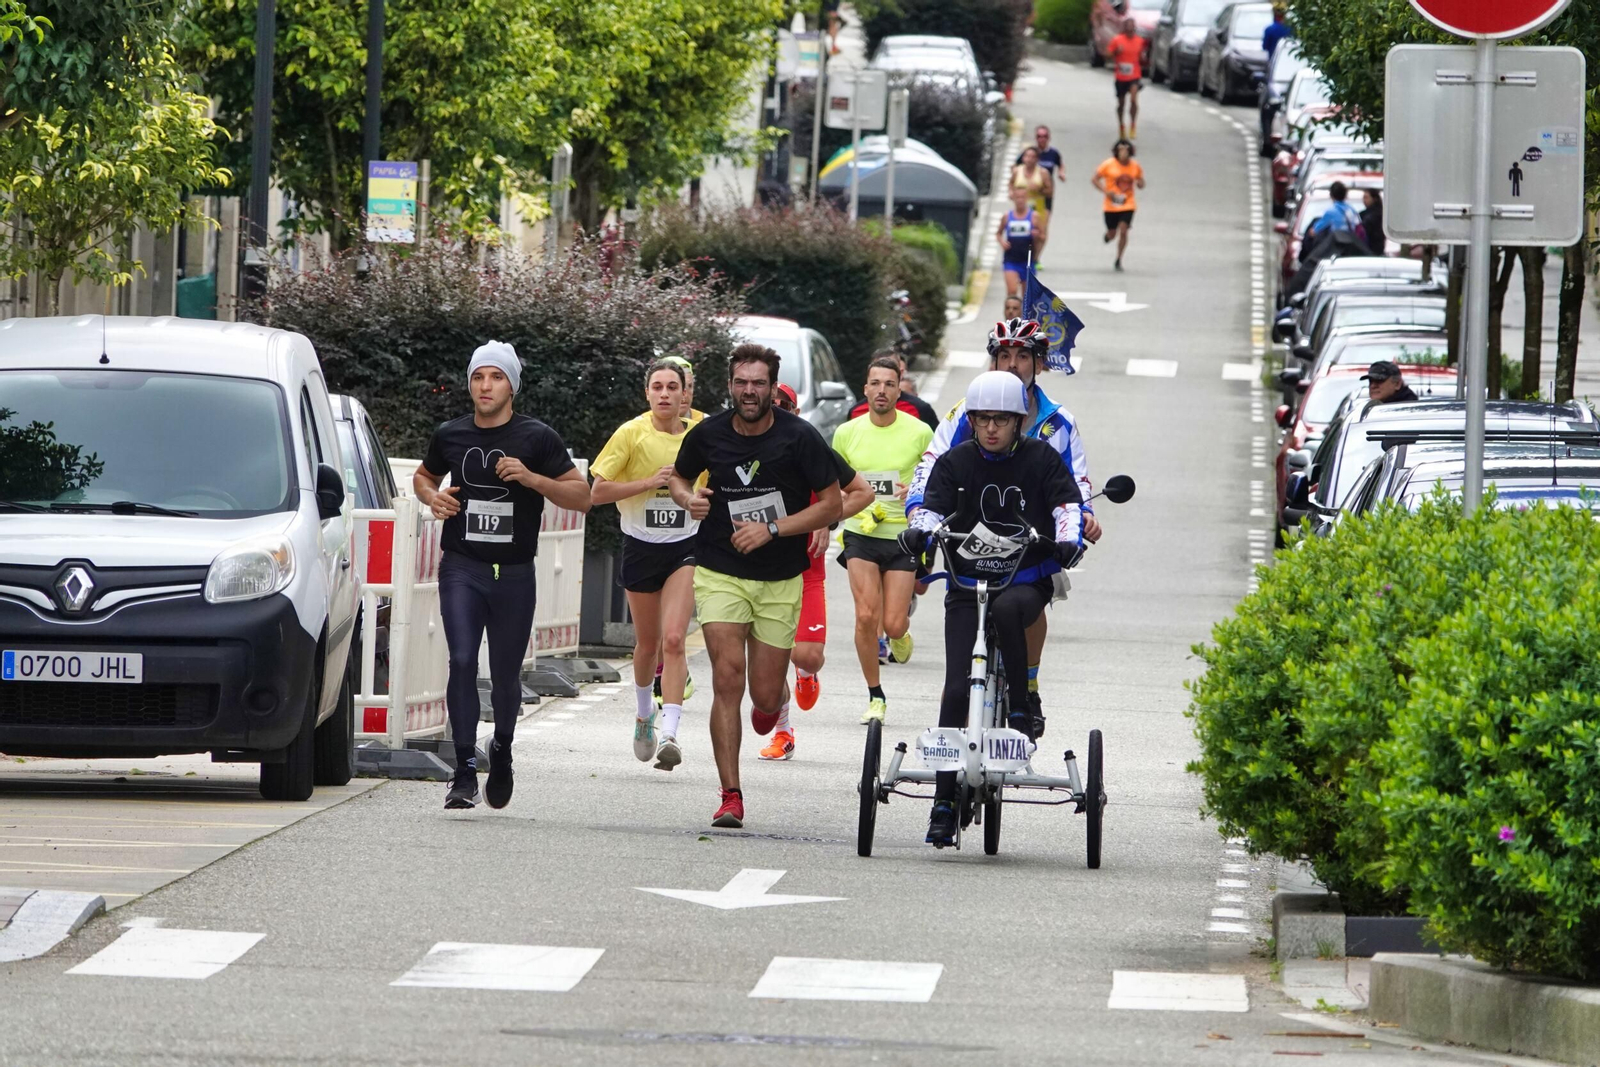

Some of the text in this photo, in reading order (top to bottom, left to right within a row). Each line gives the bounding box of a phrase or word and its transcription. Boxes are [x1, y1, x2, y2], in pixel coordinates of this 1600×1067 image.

[477, 514, 500, 531] 119
[653, 510, 677, 525] 109
[6, 667, 12, 675] E
[20, 655, 136, 679] 0700 JHL
